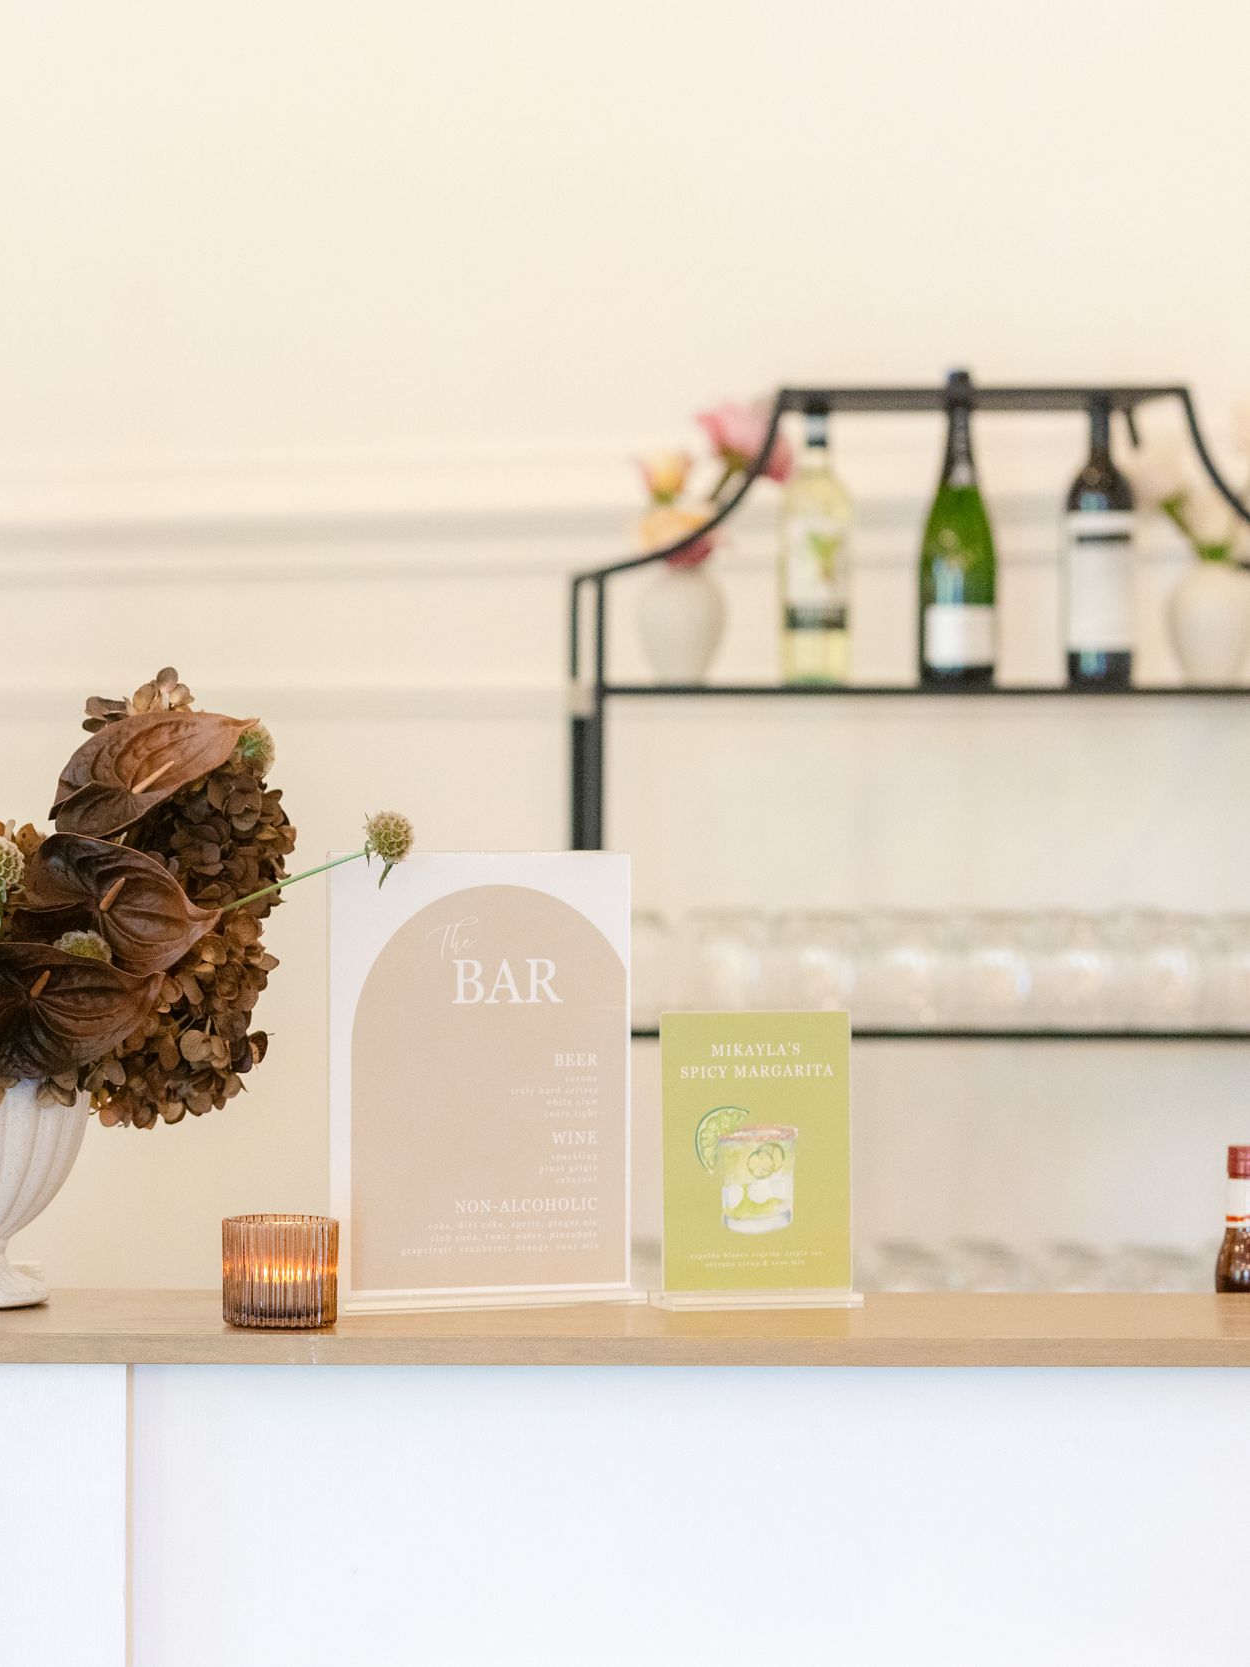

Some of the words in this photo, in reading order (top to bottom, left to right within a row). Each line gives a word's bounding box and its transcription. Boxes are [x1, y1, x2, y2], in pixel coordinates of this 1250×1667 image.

[426, 917, 478, 960] The
[452, 958, 563, 1004] BAR
[711, 1042, 801, 1057] MIKAYLA'S
[554, 1053, 598, 1067] BEER
[680, 1065, 728, 1079] SPICY
[734, 1063, 834, 1078] MARGARITA
[510, 1086, 535, 1097] truly
[552, 1131, 598, 1145] WINE
[455, 1197, 598, 1214] NON-ALCOHOLIC
